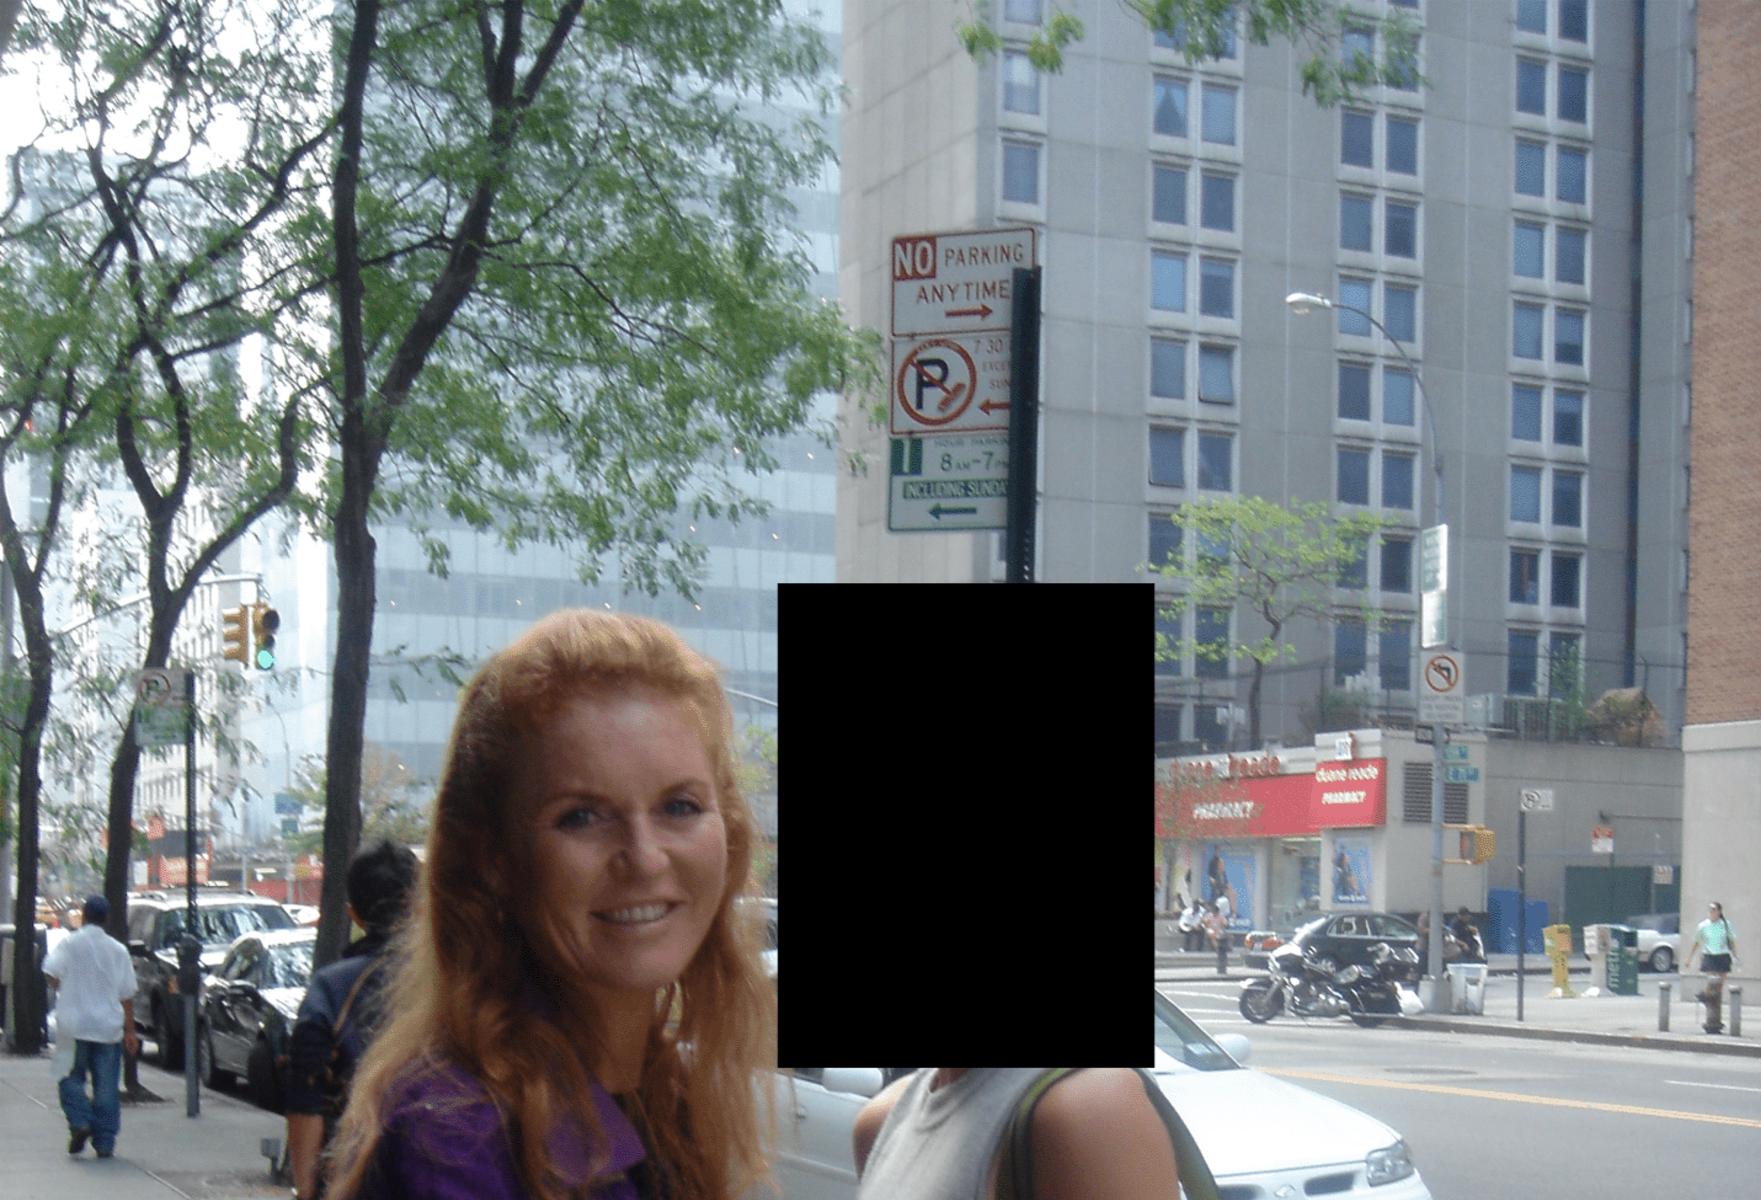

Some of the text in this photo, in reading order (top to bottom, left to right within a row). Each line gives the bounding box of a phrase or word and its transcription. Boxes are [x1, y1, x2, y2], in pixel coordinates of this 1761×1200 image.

[894, 241, 1024, 277] NO PARKING
[982, 360, 1010, 372] EXCE
[989, 379, 1010, 390] SUN
[971, 438, 1009, 447] PARKIN
[966, 480, 1008, 496] SUNDA
